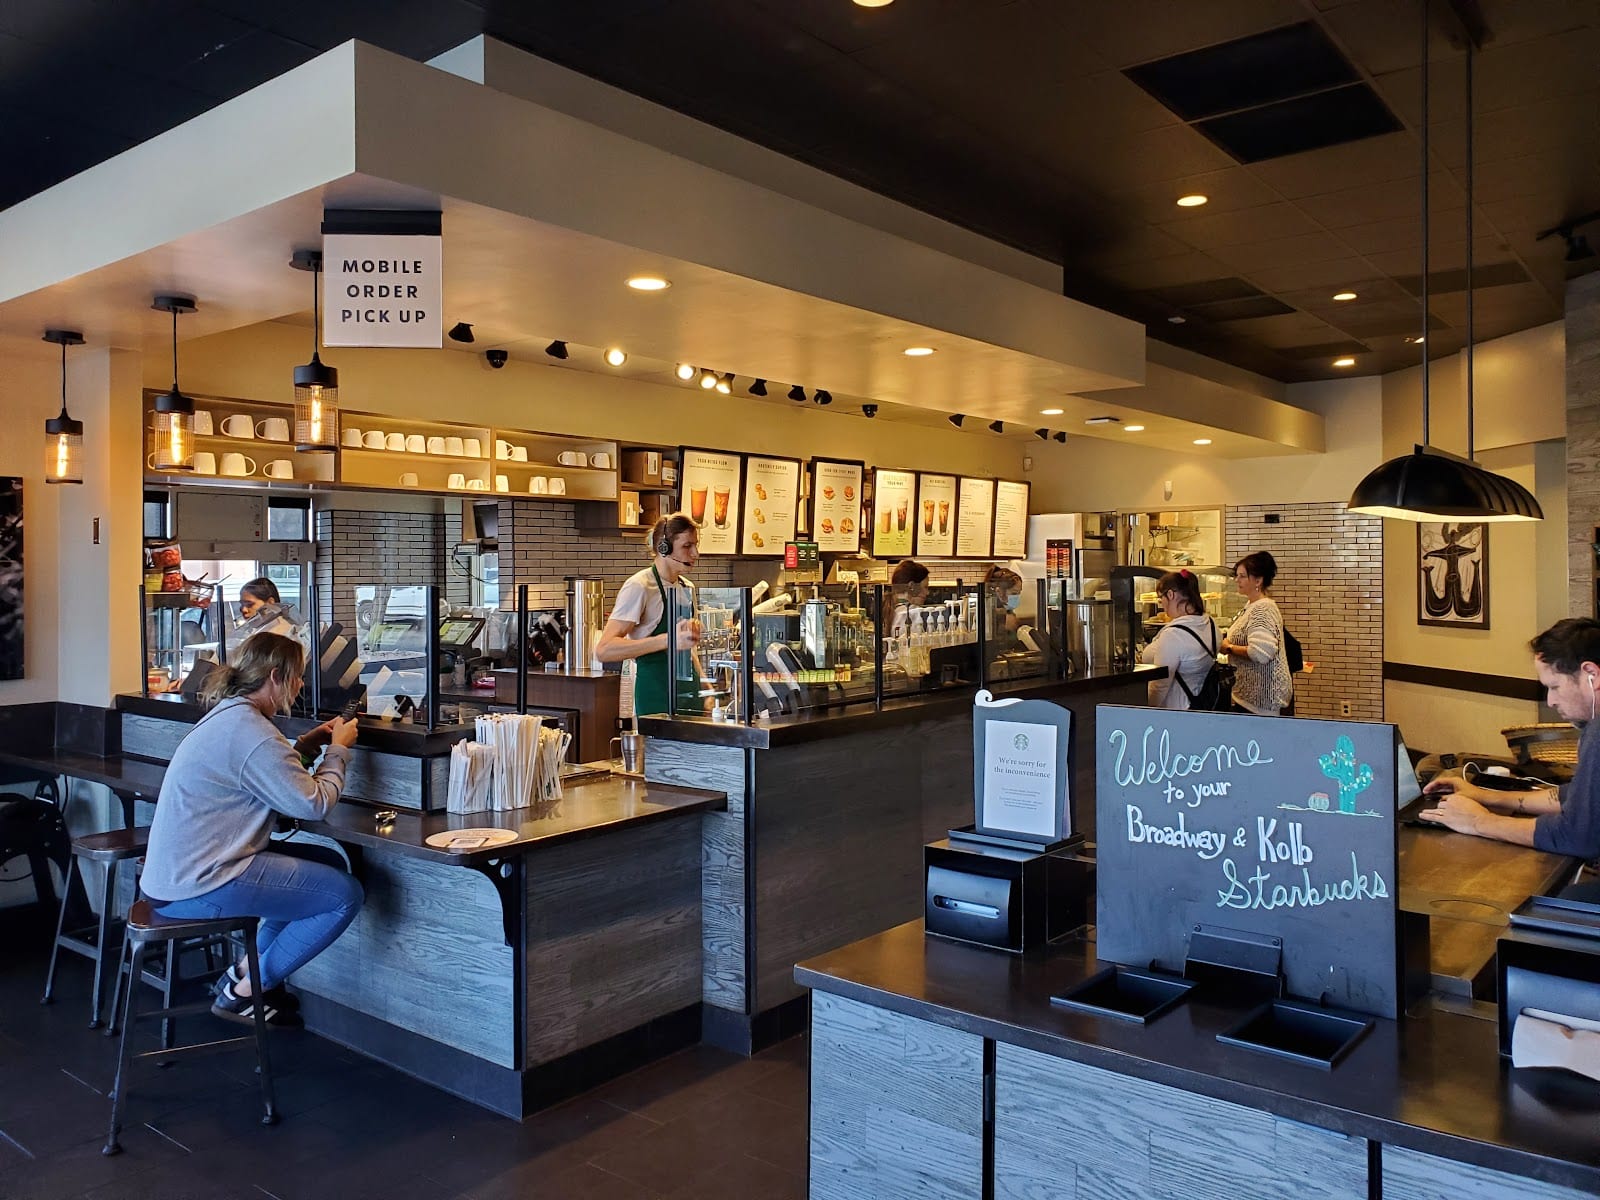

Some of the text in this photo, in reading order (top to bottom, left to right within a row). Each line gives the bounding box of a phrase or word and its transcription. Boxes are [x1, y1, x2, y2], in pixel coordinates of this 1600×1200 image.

[342, 260, 422, 273] MOBILE
[346, 285, 418, 298] ORDER
[341, 309, 426, 323] PICK UP
[999, 757, 1018, 765] We're
[1018, 760, 1034, 768] sorry
[1109, 725, 1274, 786] Welcome
[1005, 768, 1050, 778] inconvenience
[1163, 780, 1232, 808] to your
[1126, 804, 1314, 866] Broadway & Kolb
[1216, 851, 1390, 911] Starbucks
